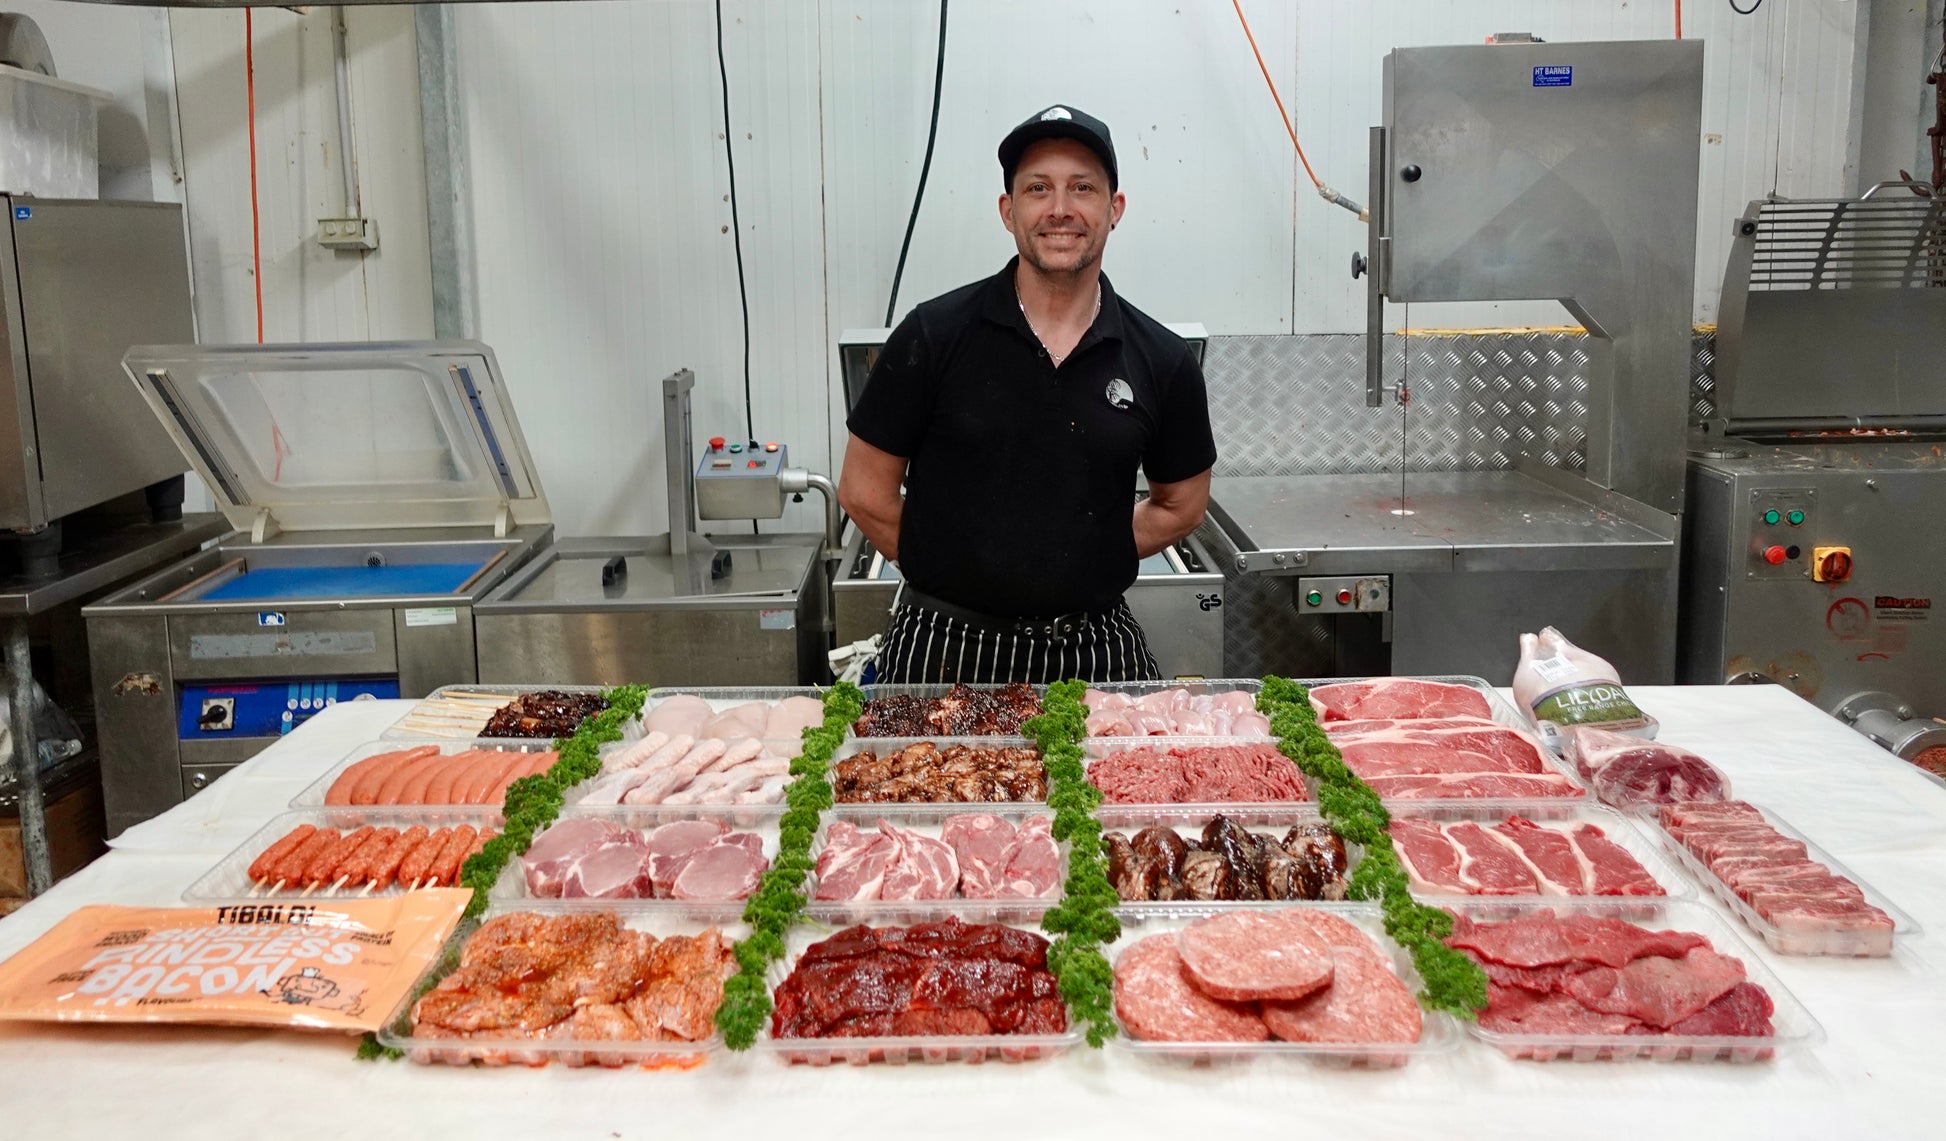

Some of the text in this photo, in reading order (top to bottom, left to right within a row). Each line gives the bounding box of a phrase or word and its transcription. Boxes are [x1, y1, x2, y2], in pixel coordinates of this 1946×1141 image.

[1535, 66, 1570, 75] HT BARNES
[1877, 598, 1929, 607] CAUTION
[1567, 703, 1587, 713] FREE
[1588, 701, 1614, 711] RANGE
[216, 904, 317, 926] TIBALDI
[350, 935, 392, 946] PROTEIN
[79, 936, 361, 970] RINDLESS
[77, 956, 298, 1007] BACON
